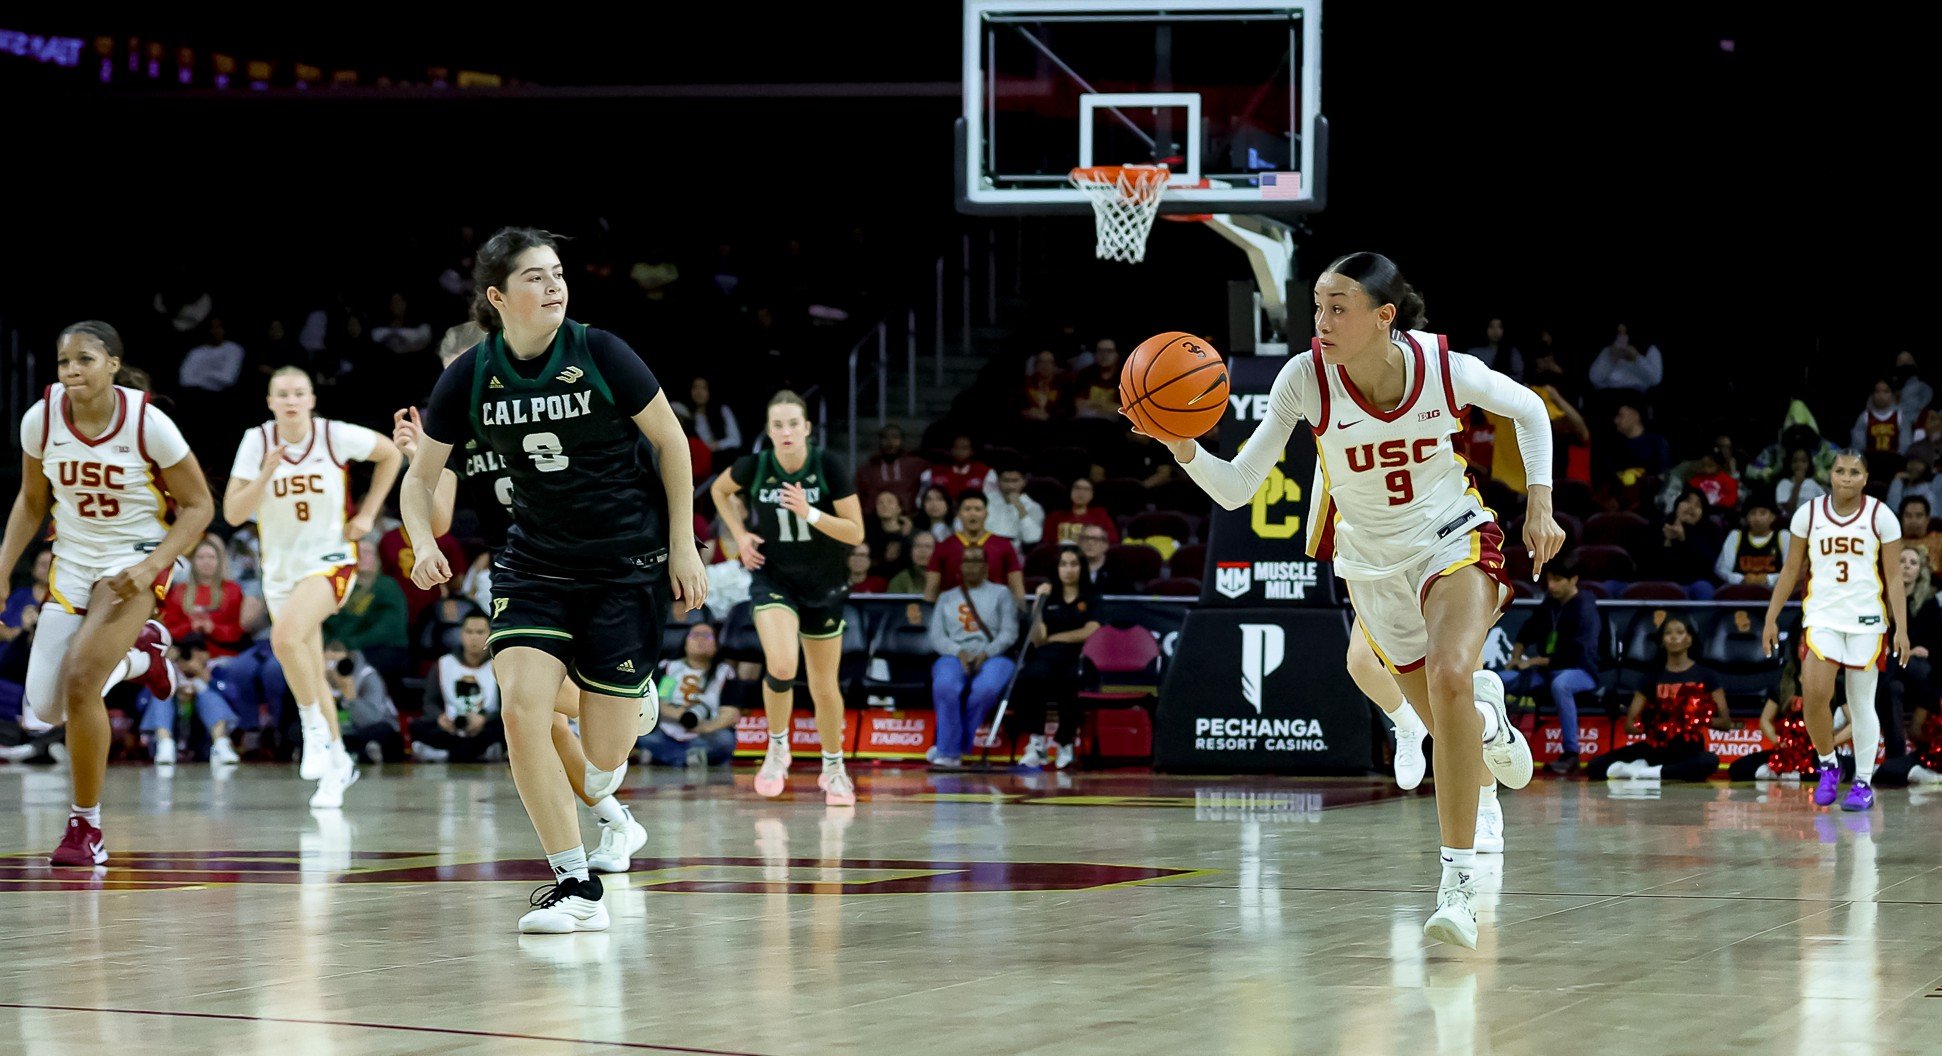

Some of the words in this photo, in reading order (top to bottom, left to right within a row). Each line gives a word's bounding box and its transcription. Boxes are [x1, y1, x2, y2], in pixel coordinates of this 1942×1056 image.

[482, 400, 528, 426] CAL
[531, 389, 592, 423] POLY
[1230, 394, 1269, 421] YE
[466, 451, 498, 476] CAL
[1345, 438, 1438, 473] USC
[59, 461, 125, 491] USC
[274, 474, 324, 498] USC
[1385, 469, 1415, 507] 9
[75, 492, 121, 518] 25
[295, 501, 310, 522] 8
[776, 508, 812, 542] 11
[1820, 536, 1865, 556] USC
[1253, 561, 1318, 581] MUSCLE
[1835, 560, 1850, 584] 3
[1264, 580, 1305, 600] MILK
[871, 718, 925, 732] WELLS
[1195, 718, 1324, 738] PECHANGA
[1708, 728, 1763, 742] WELLS
[870, 731, 924, 746] FARGO
[1194, 738, 1258, 750] RESORT
[1708, 743, 1763, 757] FARGO
